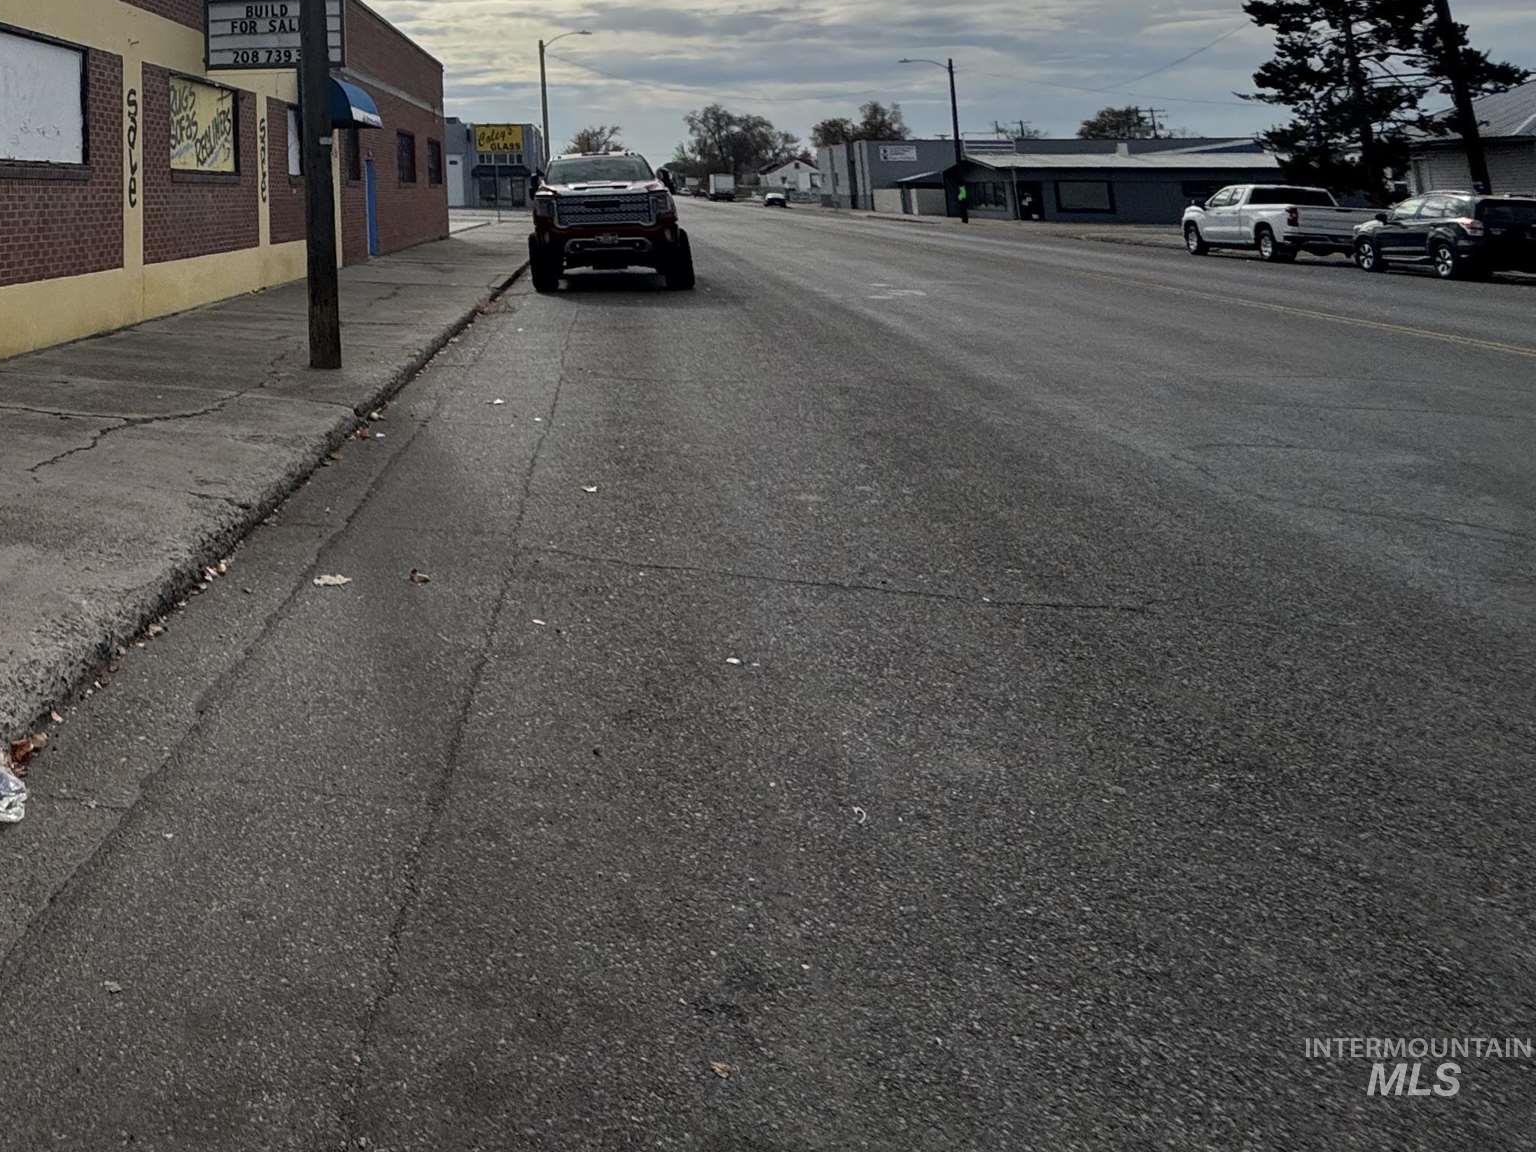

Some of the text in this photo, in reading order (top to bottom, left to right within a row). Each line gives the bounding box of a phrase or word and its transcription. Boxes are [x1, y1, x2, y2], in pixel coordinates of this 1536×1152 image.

[246, 3, 288, 18] BUILD
[231, 19, 300, 35] FOR SAL
[233, 50, 259, 64] 208
[265, 49, 292, 63] 739
